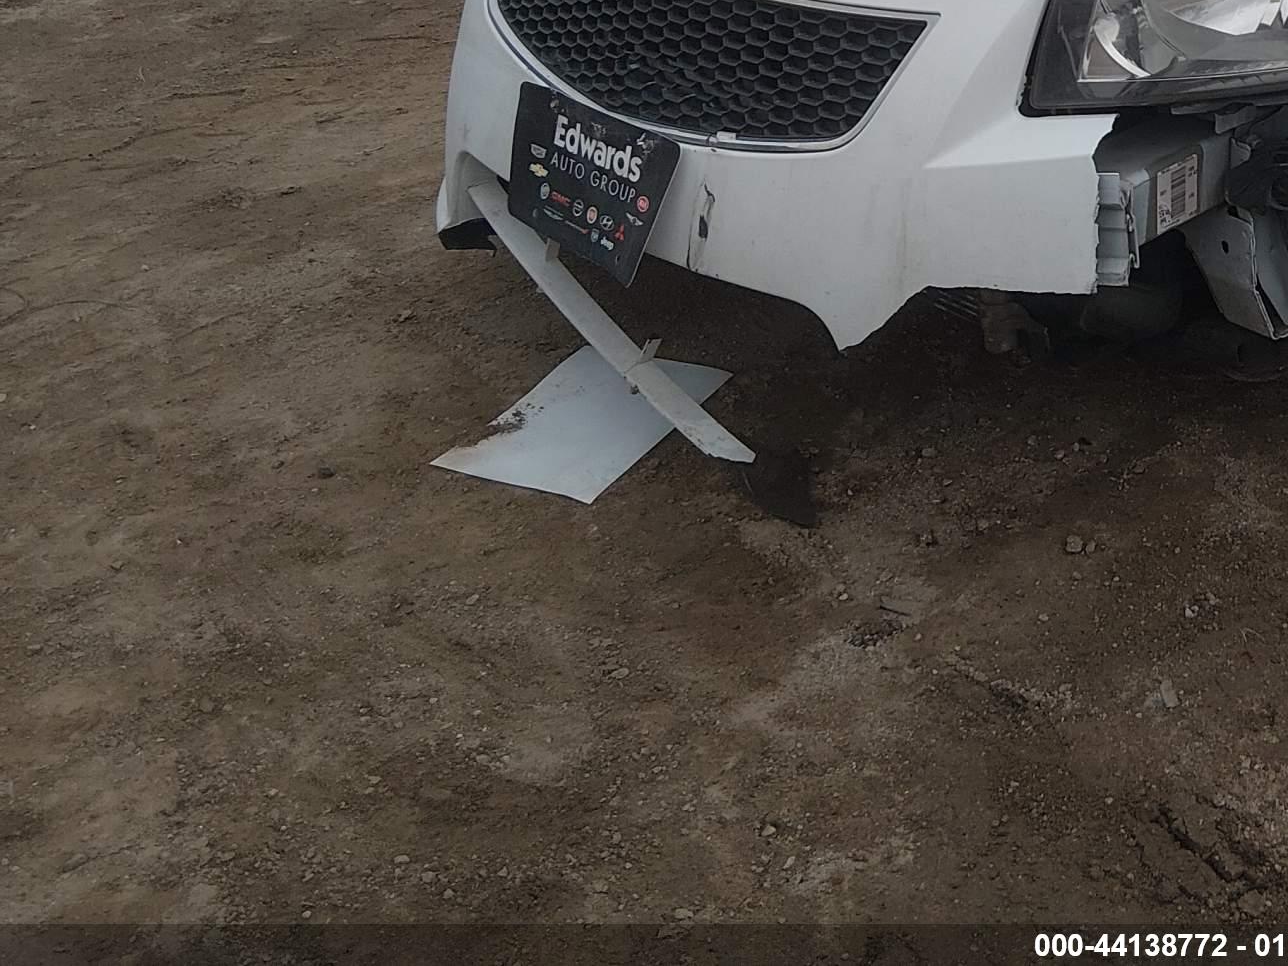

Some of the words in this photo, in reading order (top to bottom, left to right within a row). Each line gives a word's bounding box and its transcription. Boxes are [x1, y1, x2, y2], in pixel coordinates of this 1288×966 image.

[550, 151, 585, 179] AUTO
[590, 170, 637, 203] GROUP
[553, 114, 643, 183] Edwards
